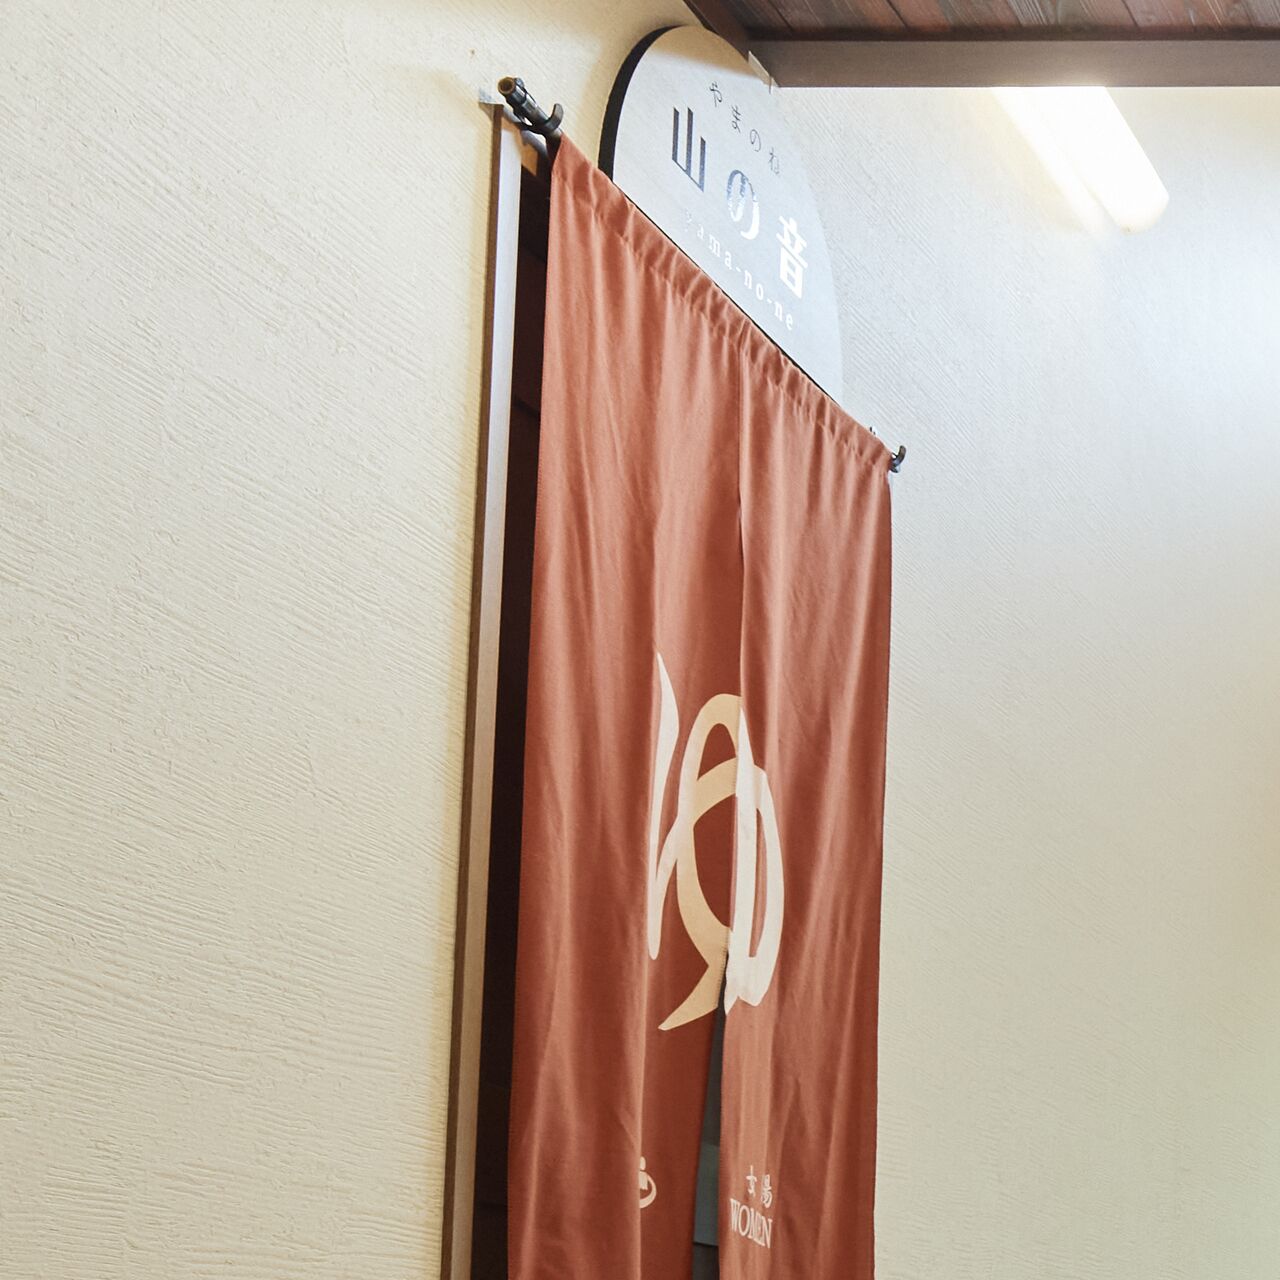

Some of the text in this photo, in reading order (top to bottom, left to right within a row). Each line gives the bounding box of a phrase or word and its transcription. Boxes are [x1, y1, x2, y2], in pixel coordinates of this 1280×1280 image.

[671, 107, 808, 299] 山の音
[647, 652, 785, 1031] ゆ
